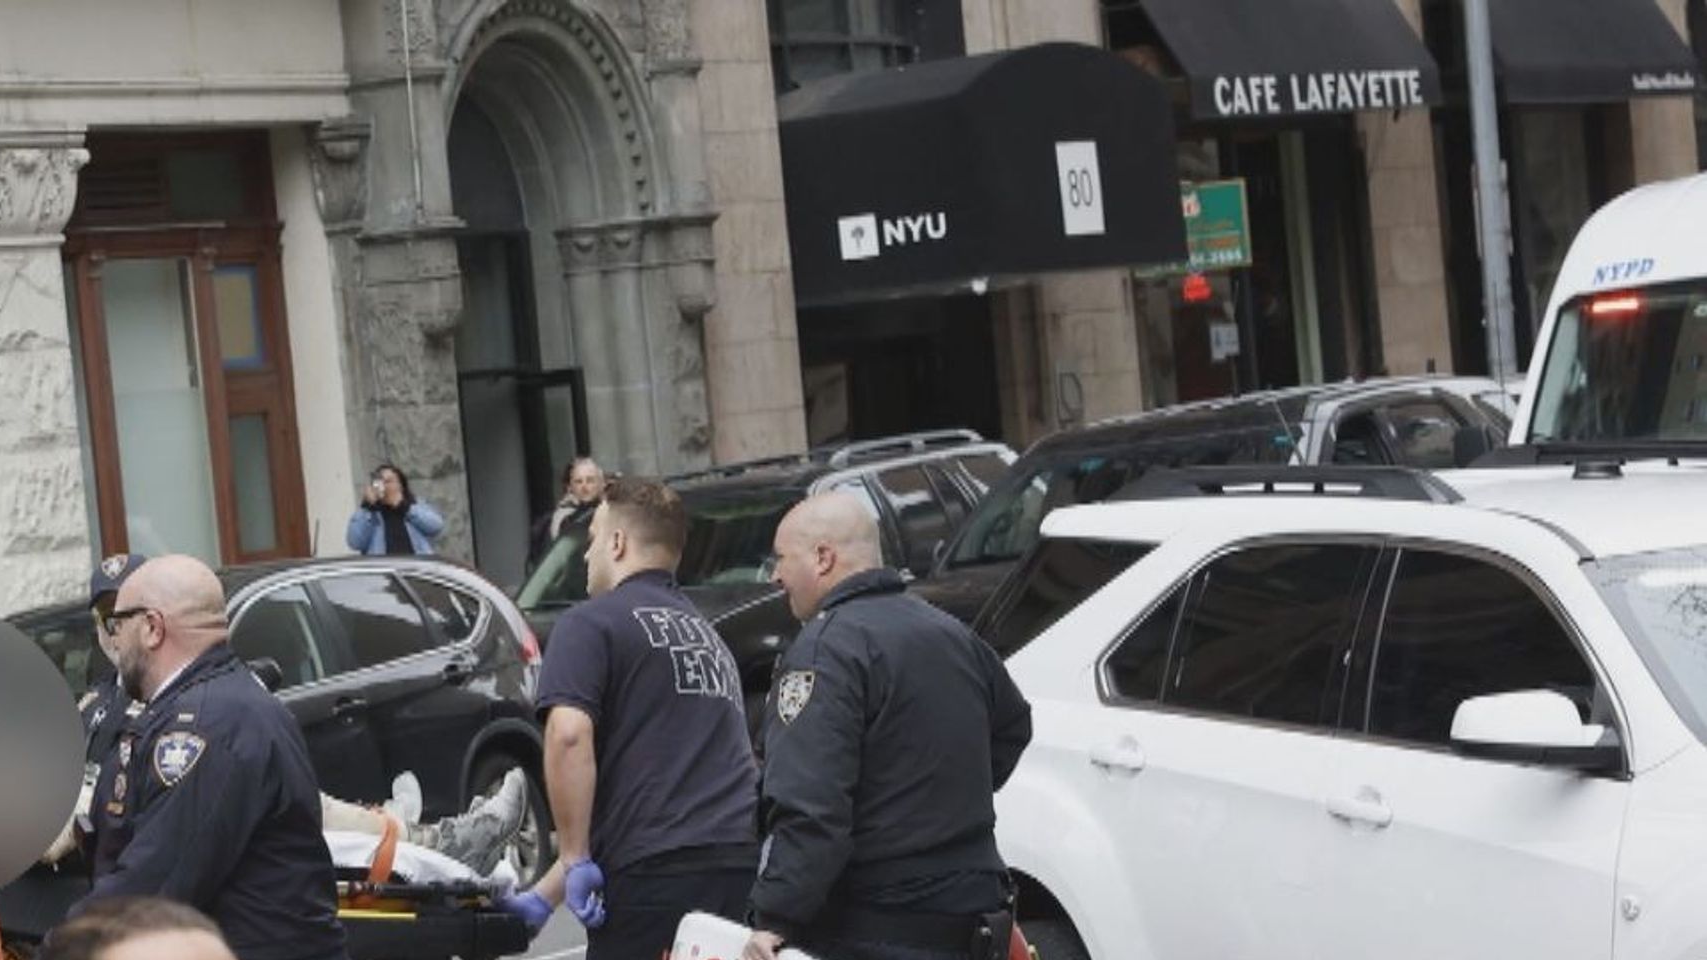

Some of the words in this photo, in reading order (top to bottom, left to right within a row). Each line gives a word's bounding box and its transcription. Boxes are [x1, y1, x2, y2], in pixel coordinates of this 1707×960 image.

[1214, 77, 1280, 115] CAFE
[1291, 71, 1422, 111] LAFAYETTE
[1068, 169, 1093, 207] 80
[883, 212, 946, 246] NYU
[1594, 258, 1654, 284] NYPD
